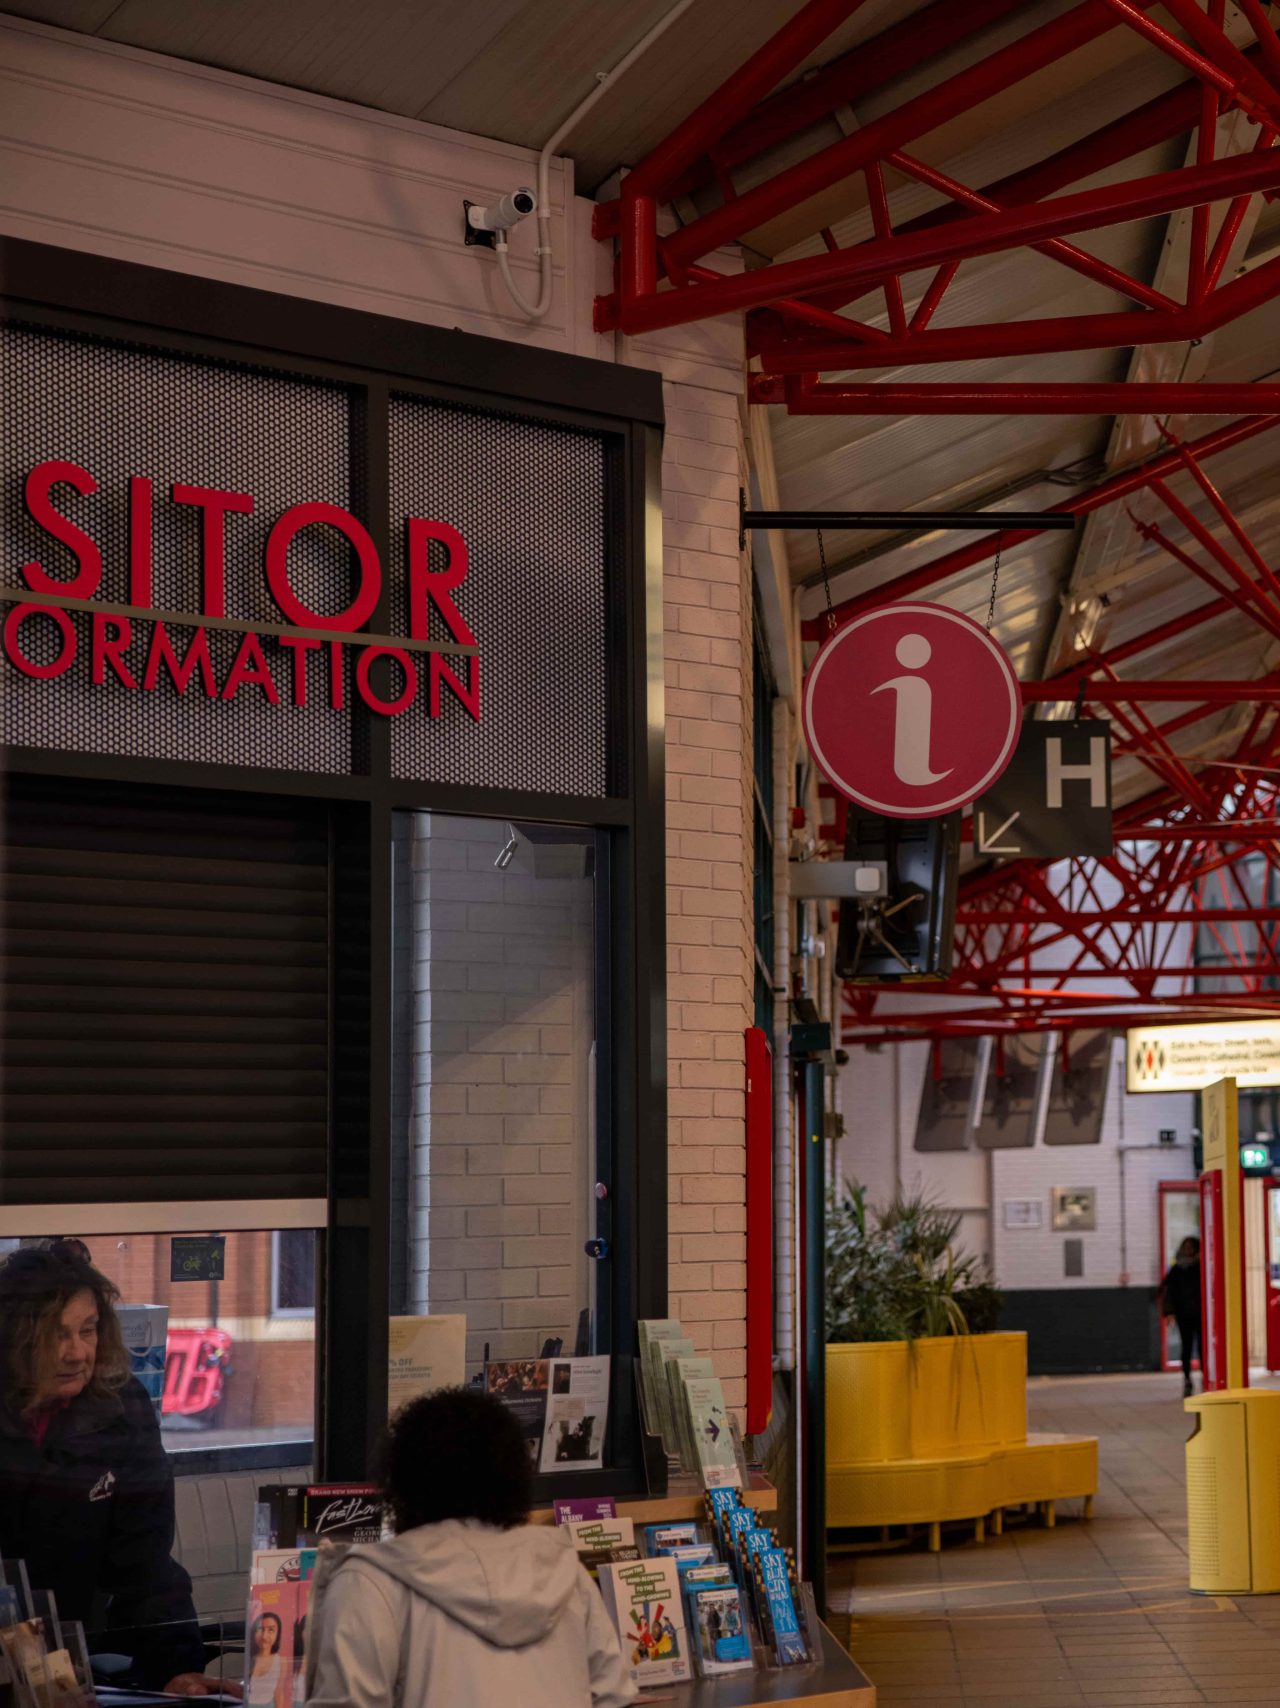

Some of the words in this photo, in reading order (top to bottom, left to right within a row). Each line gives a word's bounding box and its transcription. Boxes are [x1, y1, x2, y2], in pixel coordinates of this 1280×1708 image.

[22, 459, 479, 647] SITOR
[3, 601, 481, 722] ORMATION
[1045, 736, 1107, 808] H
[714, 1490, 734, 1506] SKY
[559, 1506, 572, 1515] THE
[732, 1511, 752, 1527] SKY
[748, 1532, 769, 1549] SKY
[763, 1552, 783, 1569] SKY
[766, 1567, 786, 1580] BLUE
[767, 1578, 788, 1594] CITY
